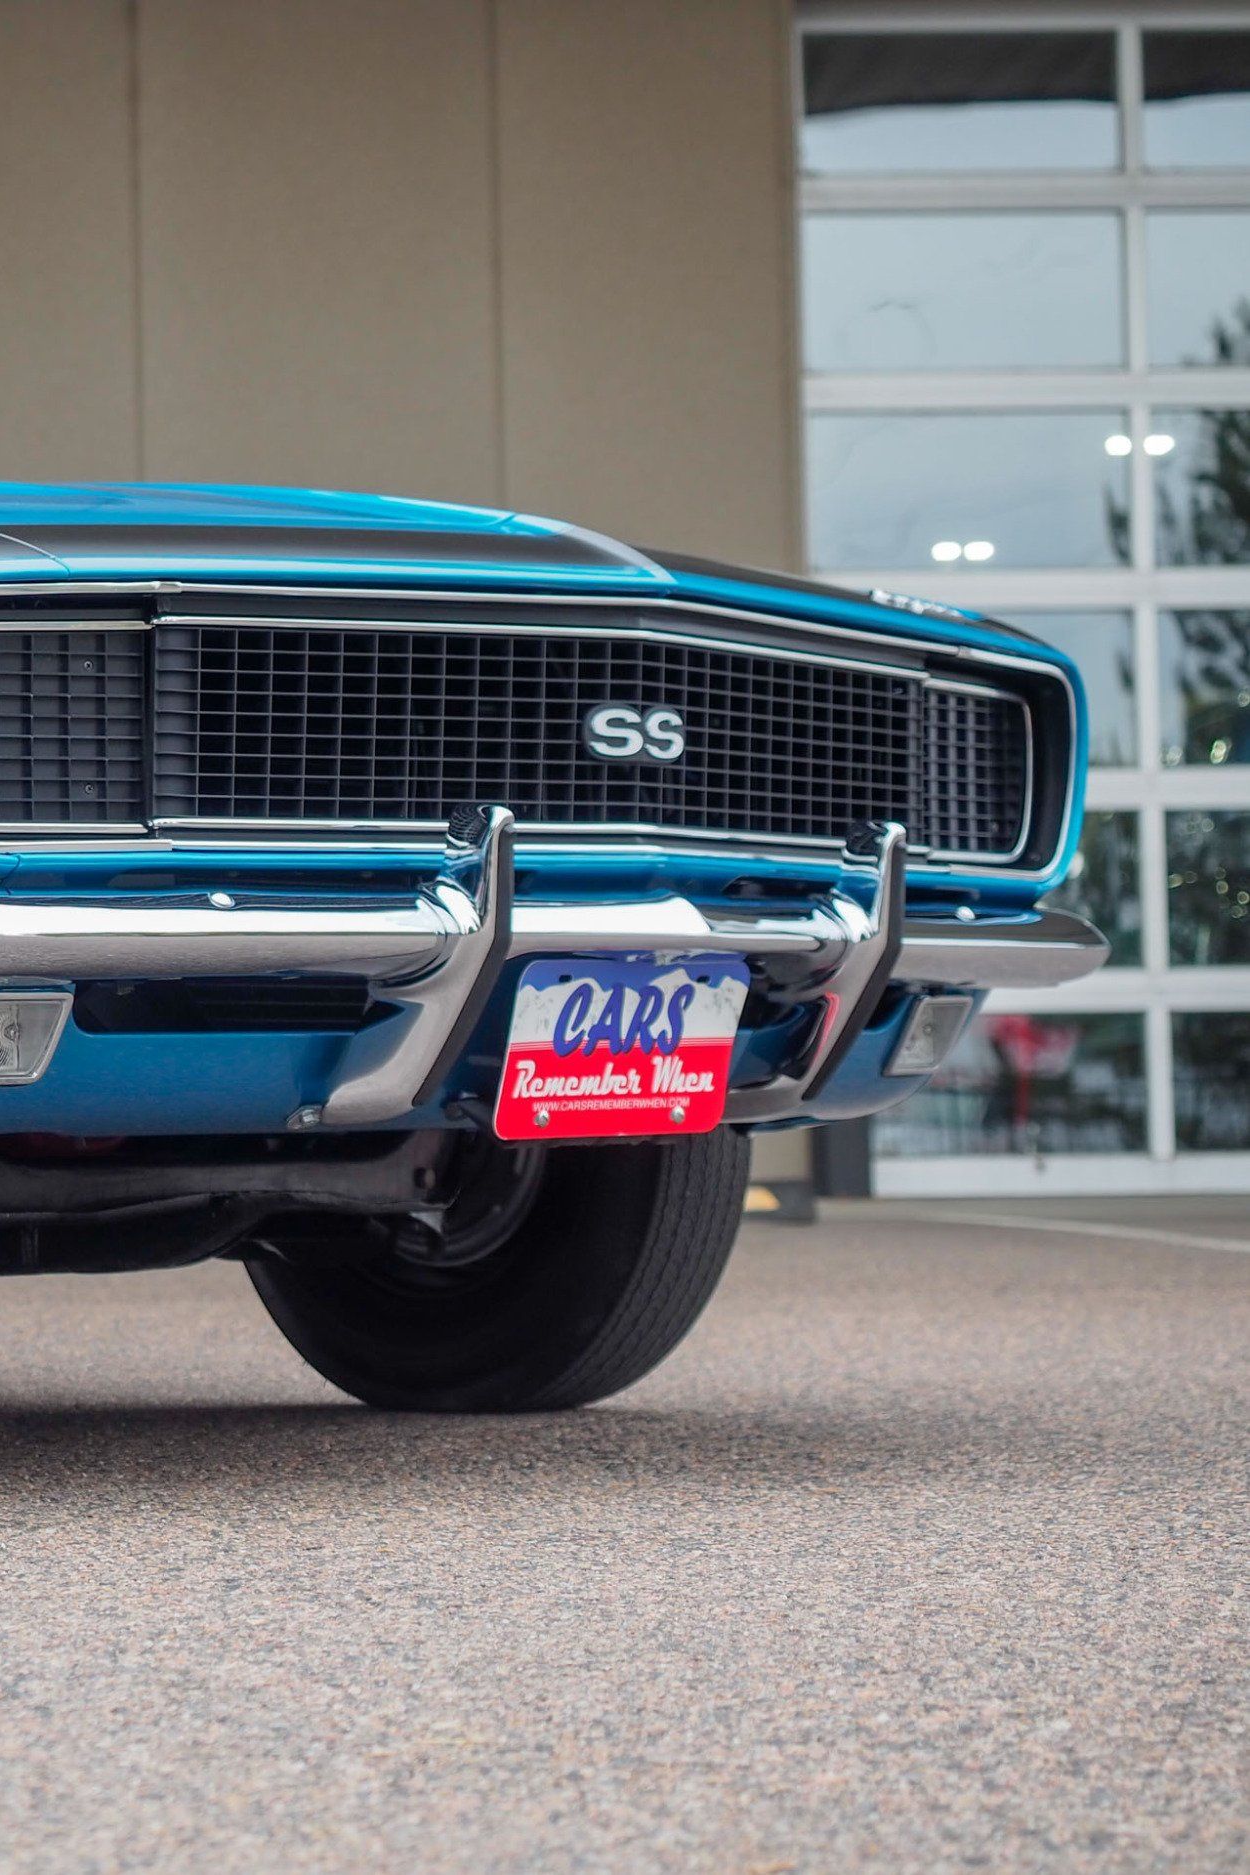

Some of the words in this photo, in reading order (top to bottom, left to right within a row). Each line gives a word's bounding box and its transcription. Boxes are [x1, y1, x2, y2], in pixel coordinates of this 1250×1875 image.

[589, 707, 685, 760] SS
[553, 983, 695, 1058] CARS
[512, 1060, 642, 1099] Remember
[651, 1056, 715, 1094] When
